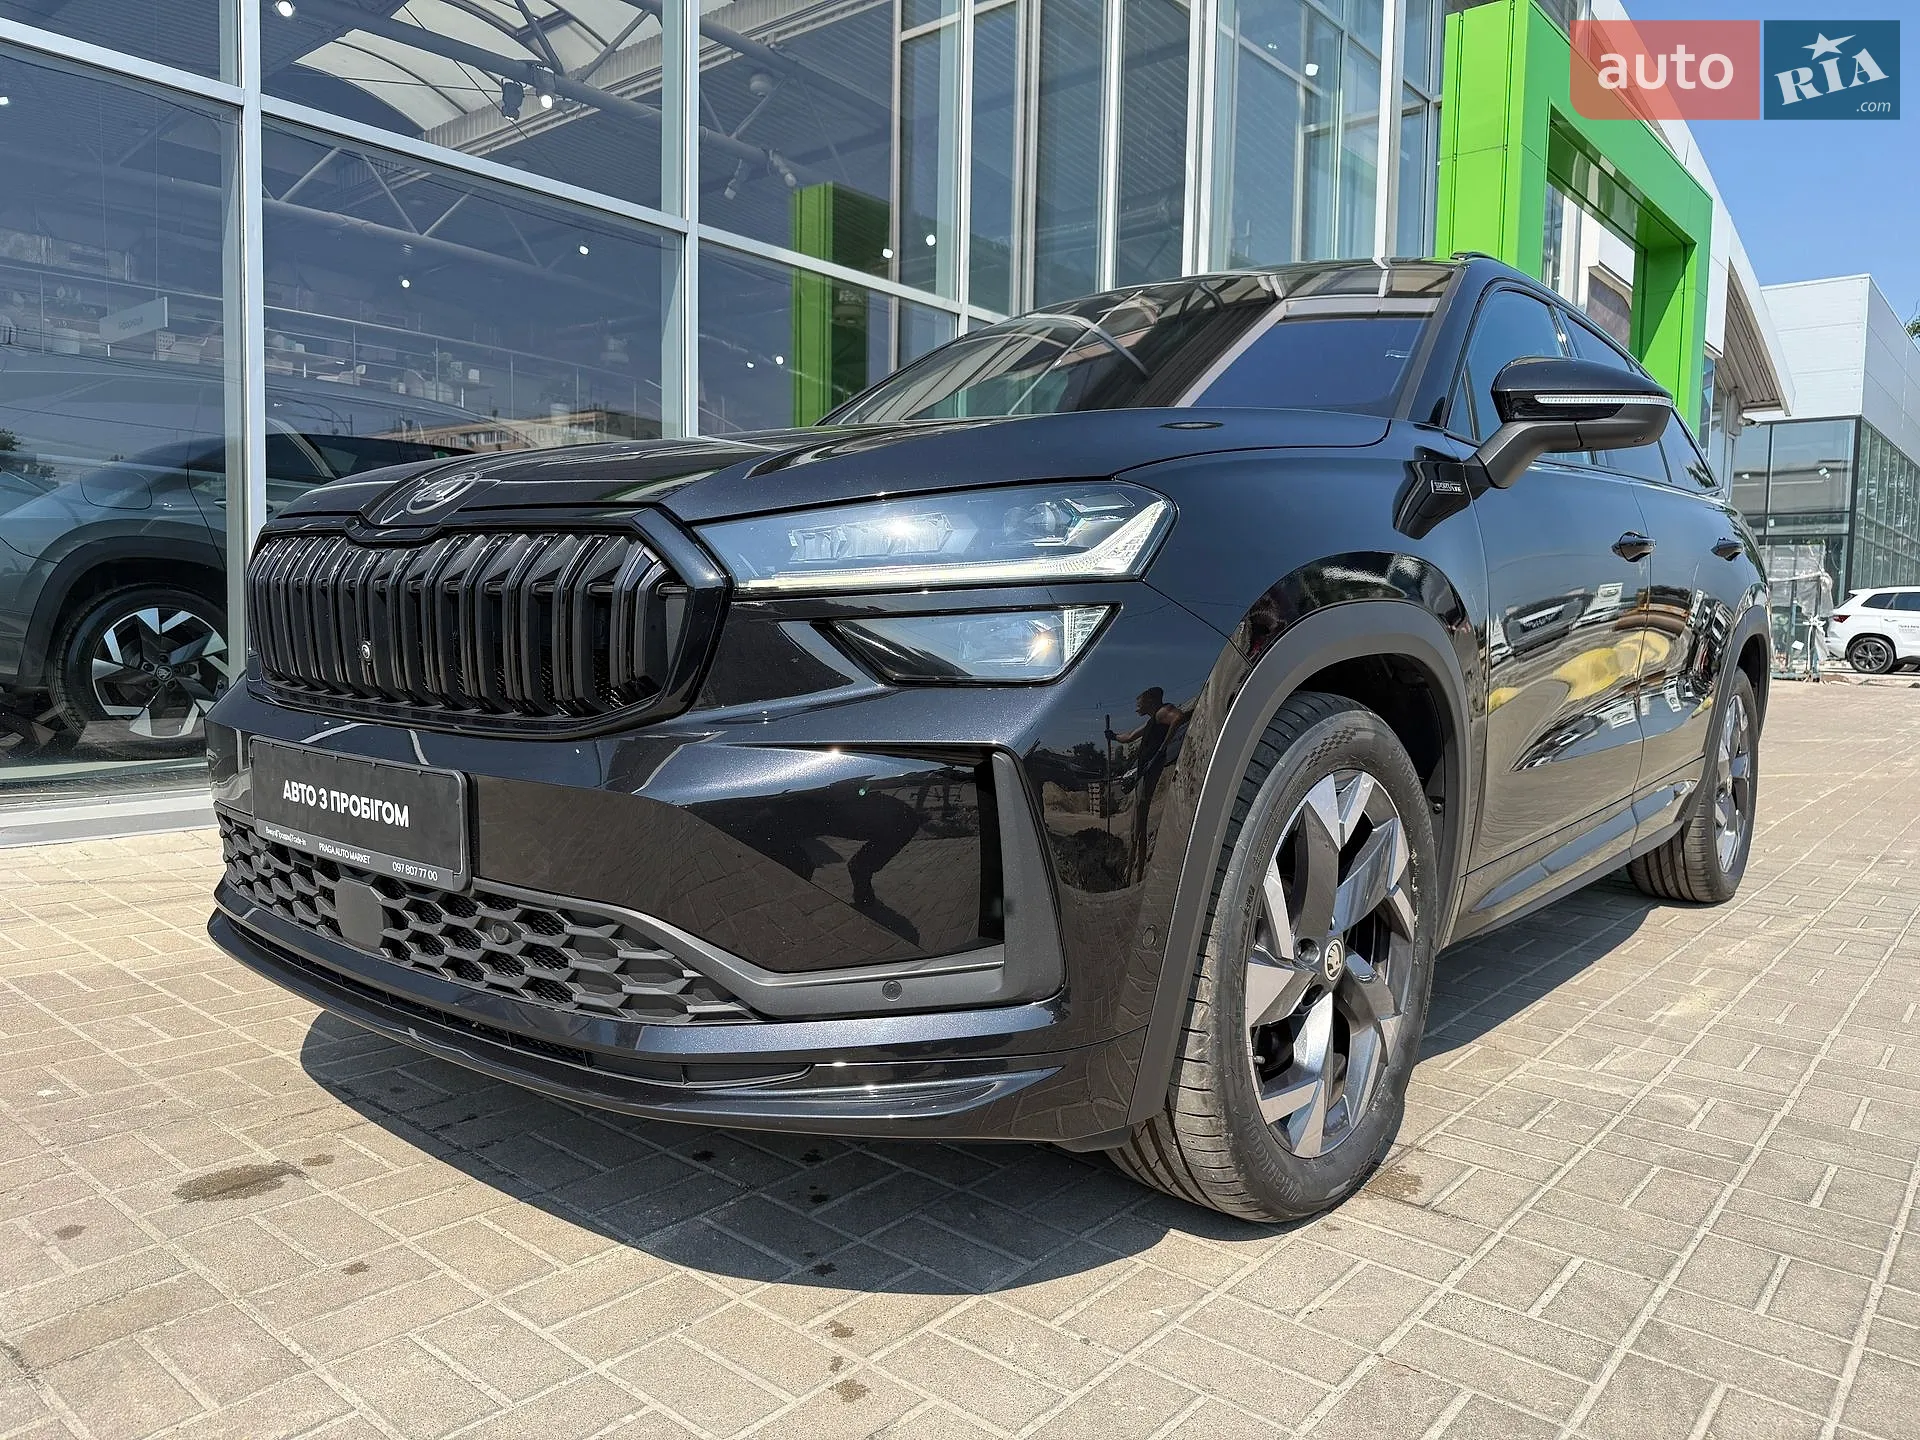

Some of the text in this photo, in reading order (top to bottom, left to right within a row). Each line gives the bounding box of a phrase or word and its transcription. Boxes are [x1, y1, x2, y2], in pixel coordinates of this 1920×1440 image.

[282, 780, 316, 806] АВТО
[330, 790, 410, 828] ПРОБІГОМ
[334, 847, 349, 859] AUTO
[349, 852, 371, 865] MARKET
[392, 861, 438, 881] 097 807 77 00
